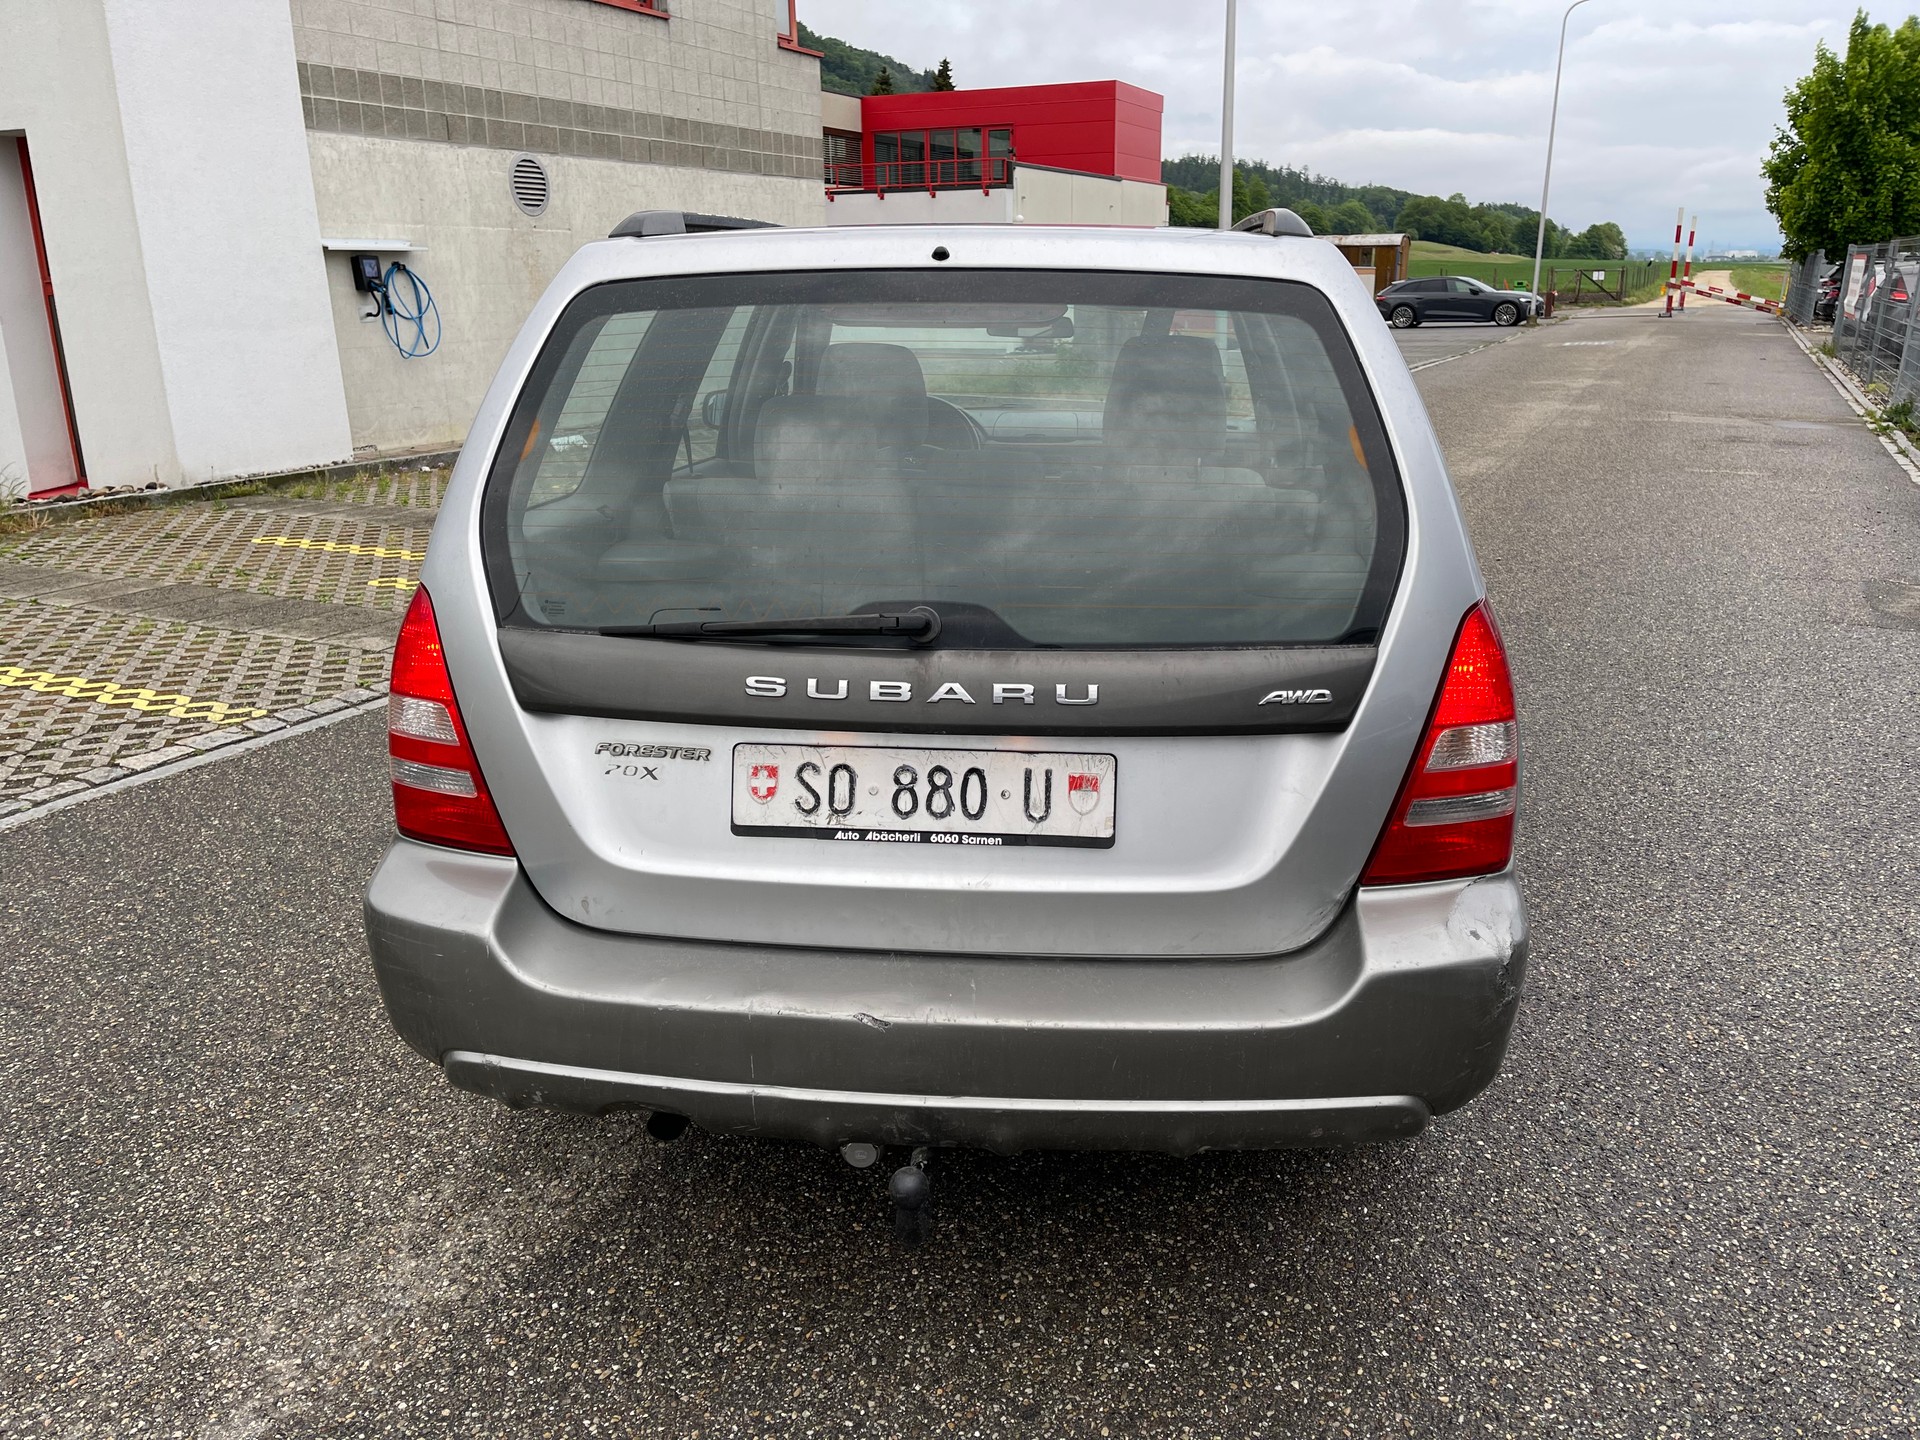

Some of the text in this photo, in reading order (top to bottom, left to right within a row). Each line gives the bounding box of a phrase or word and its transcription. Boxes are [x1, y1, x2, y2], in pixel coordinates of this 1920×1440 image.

[744, 676, 1100, 705] SUBARU
[1257, 689, 1334, 706] AWD
[594, 742, 712, 761] FORESTER
[795, 761, 1053, 824] SO 880 U
[834, 830, 1003, 846] Auto Abächerli 6060 Sarnen
